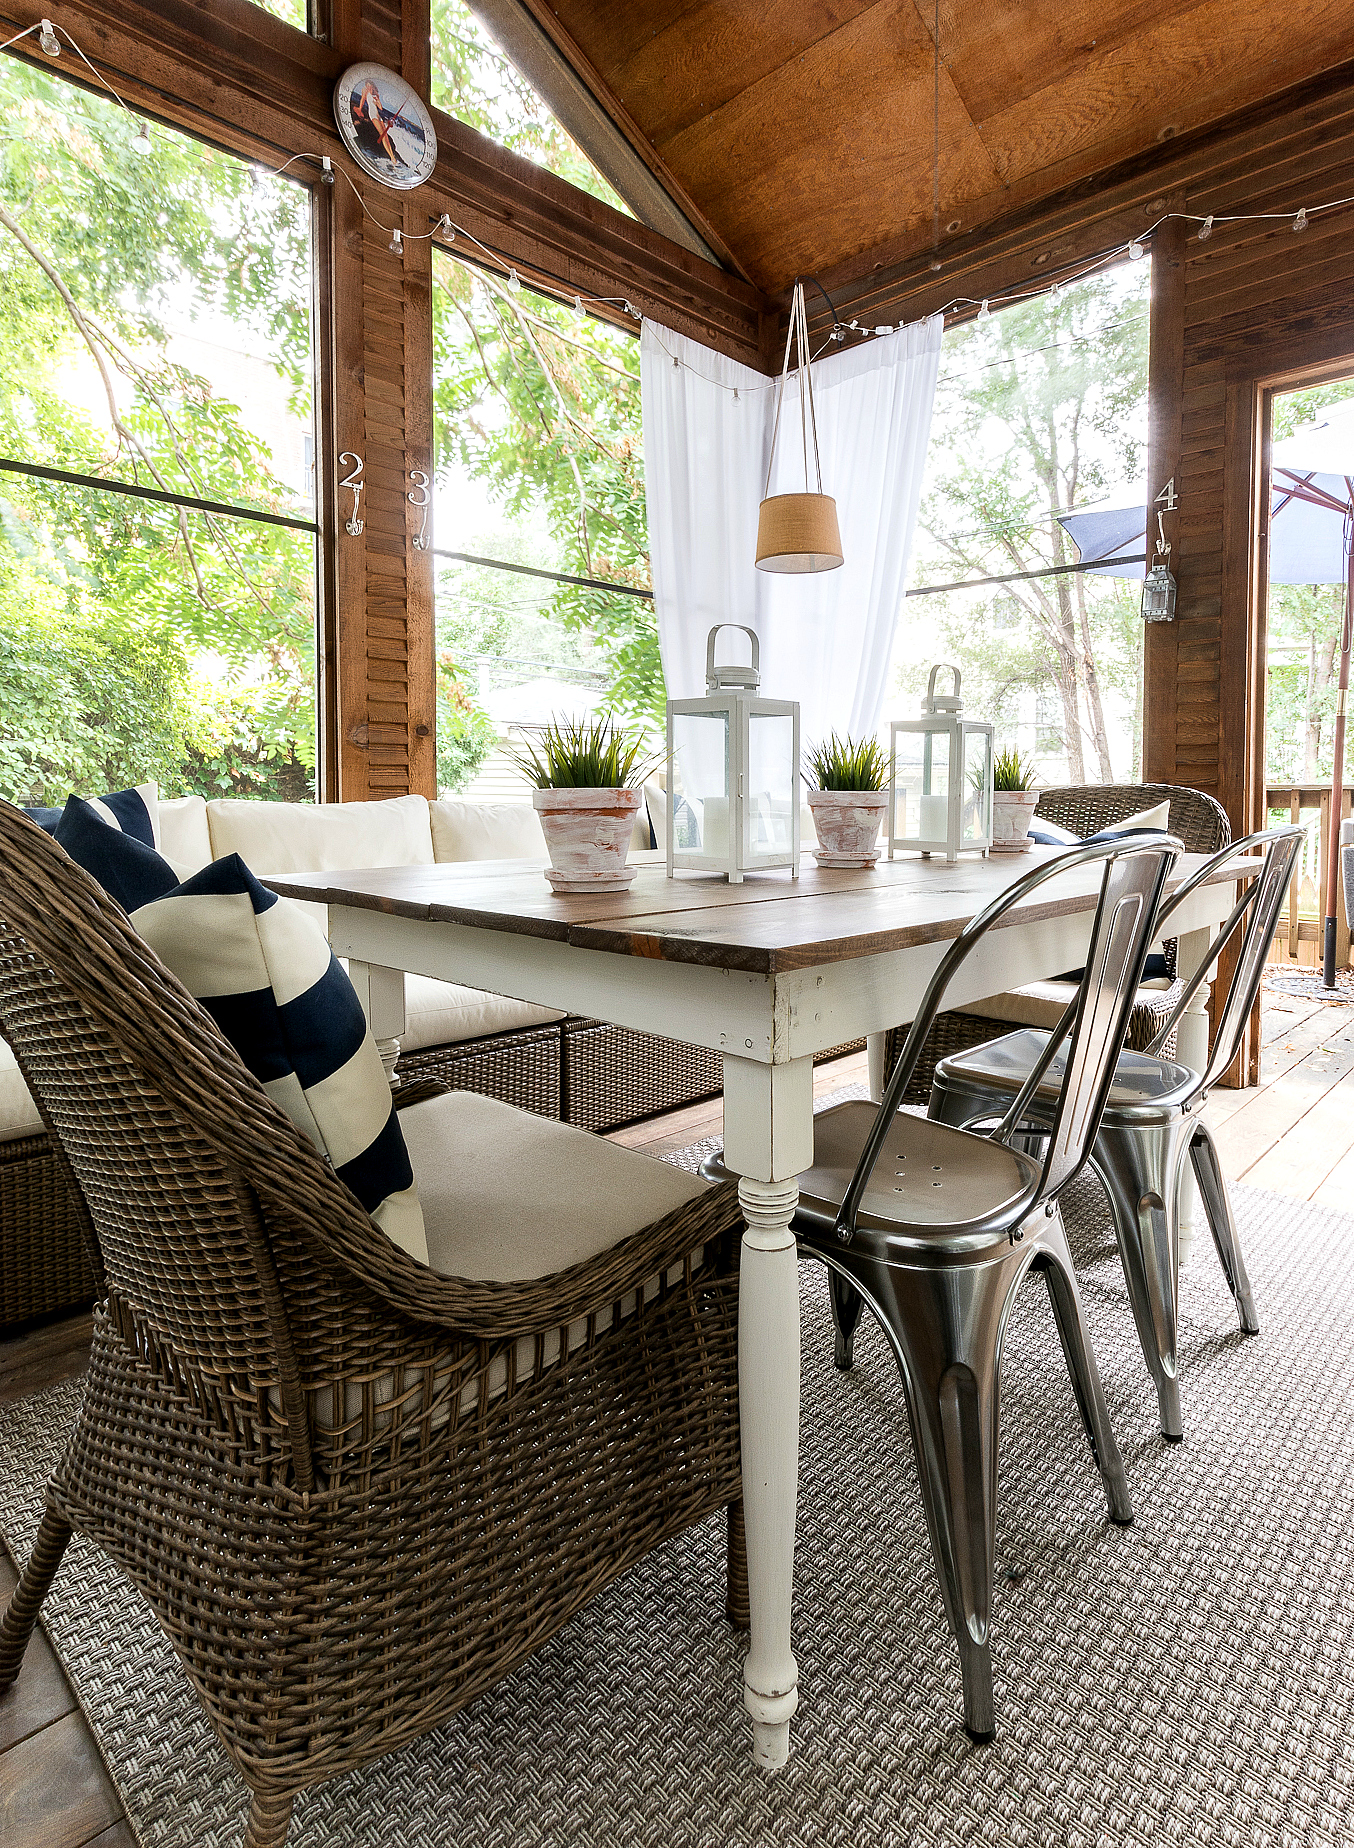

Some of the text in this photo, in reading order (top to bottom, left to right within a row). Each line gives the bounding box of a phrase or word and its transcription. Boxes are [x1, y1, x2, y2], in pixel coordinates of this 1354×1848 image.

[339, 451, 363, 490] 2
[408, 470, 431, 506] 3
[1154, 477, 1178, 511] 4
